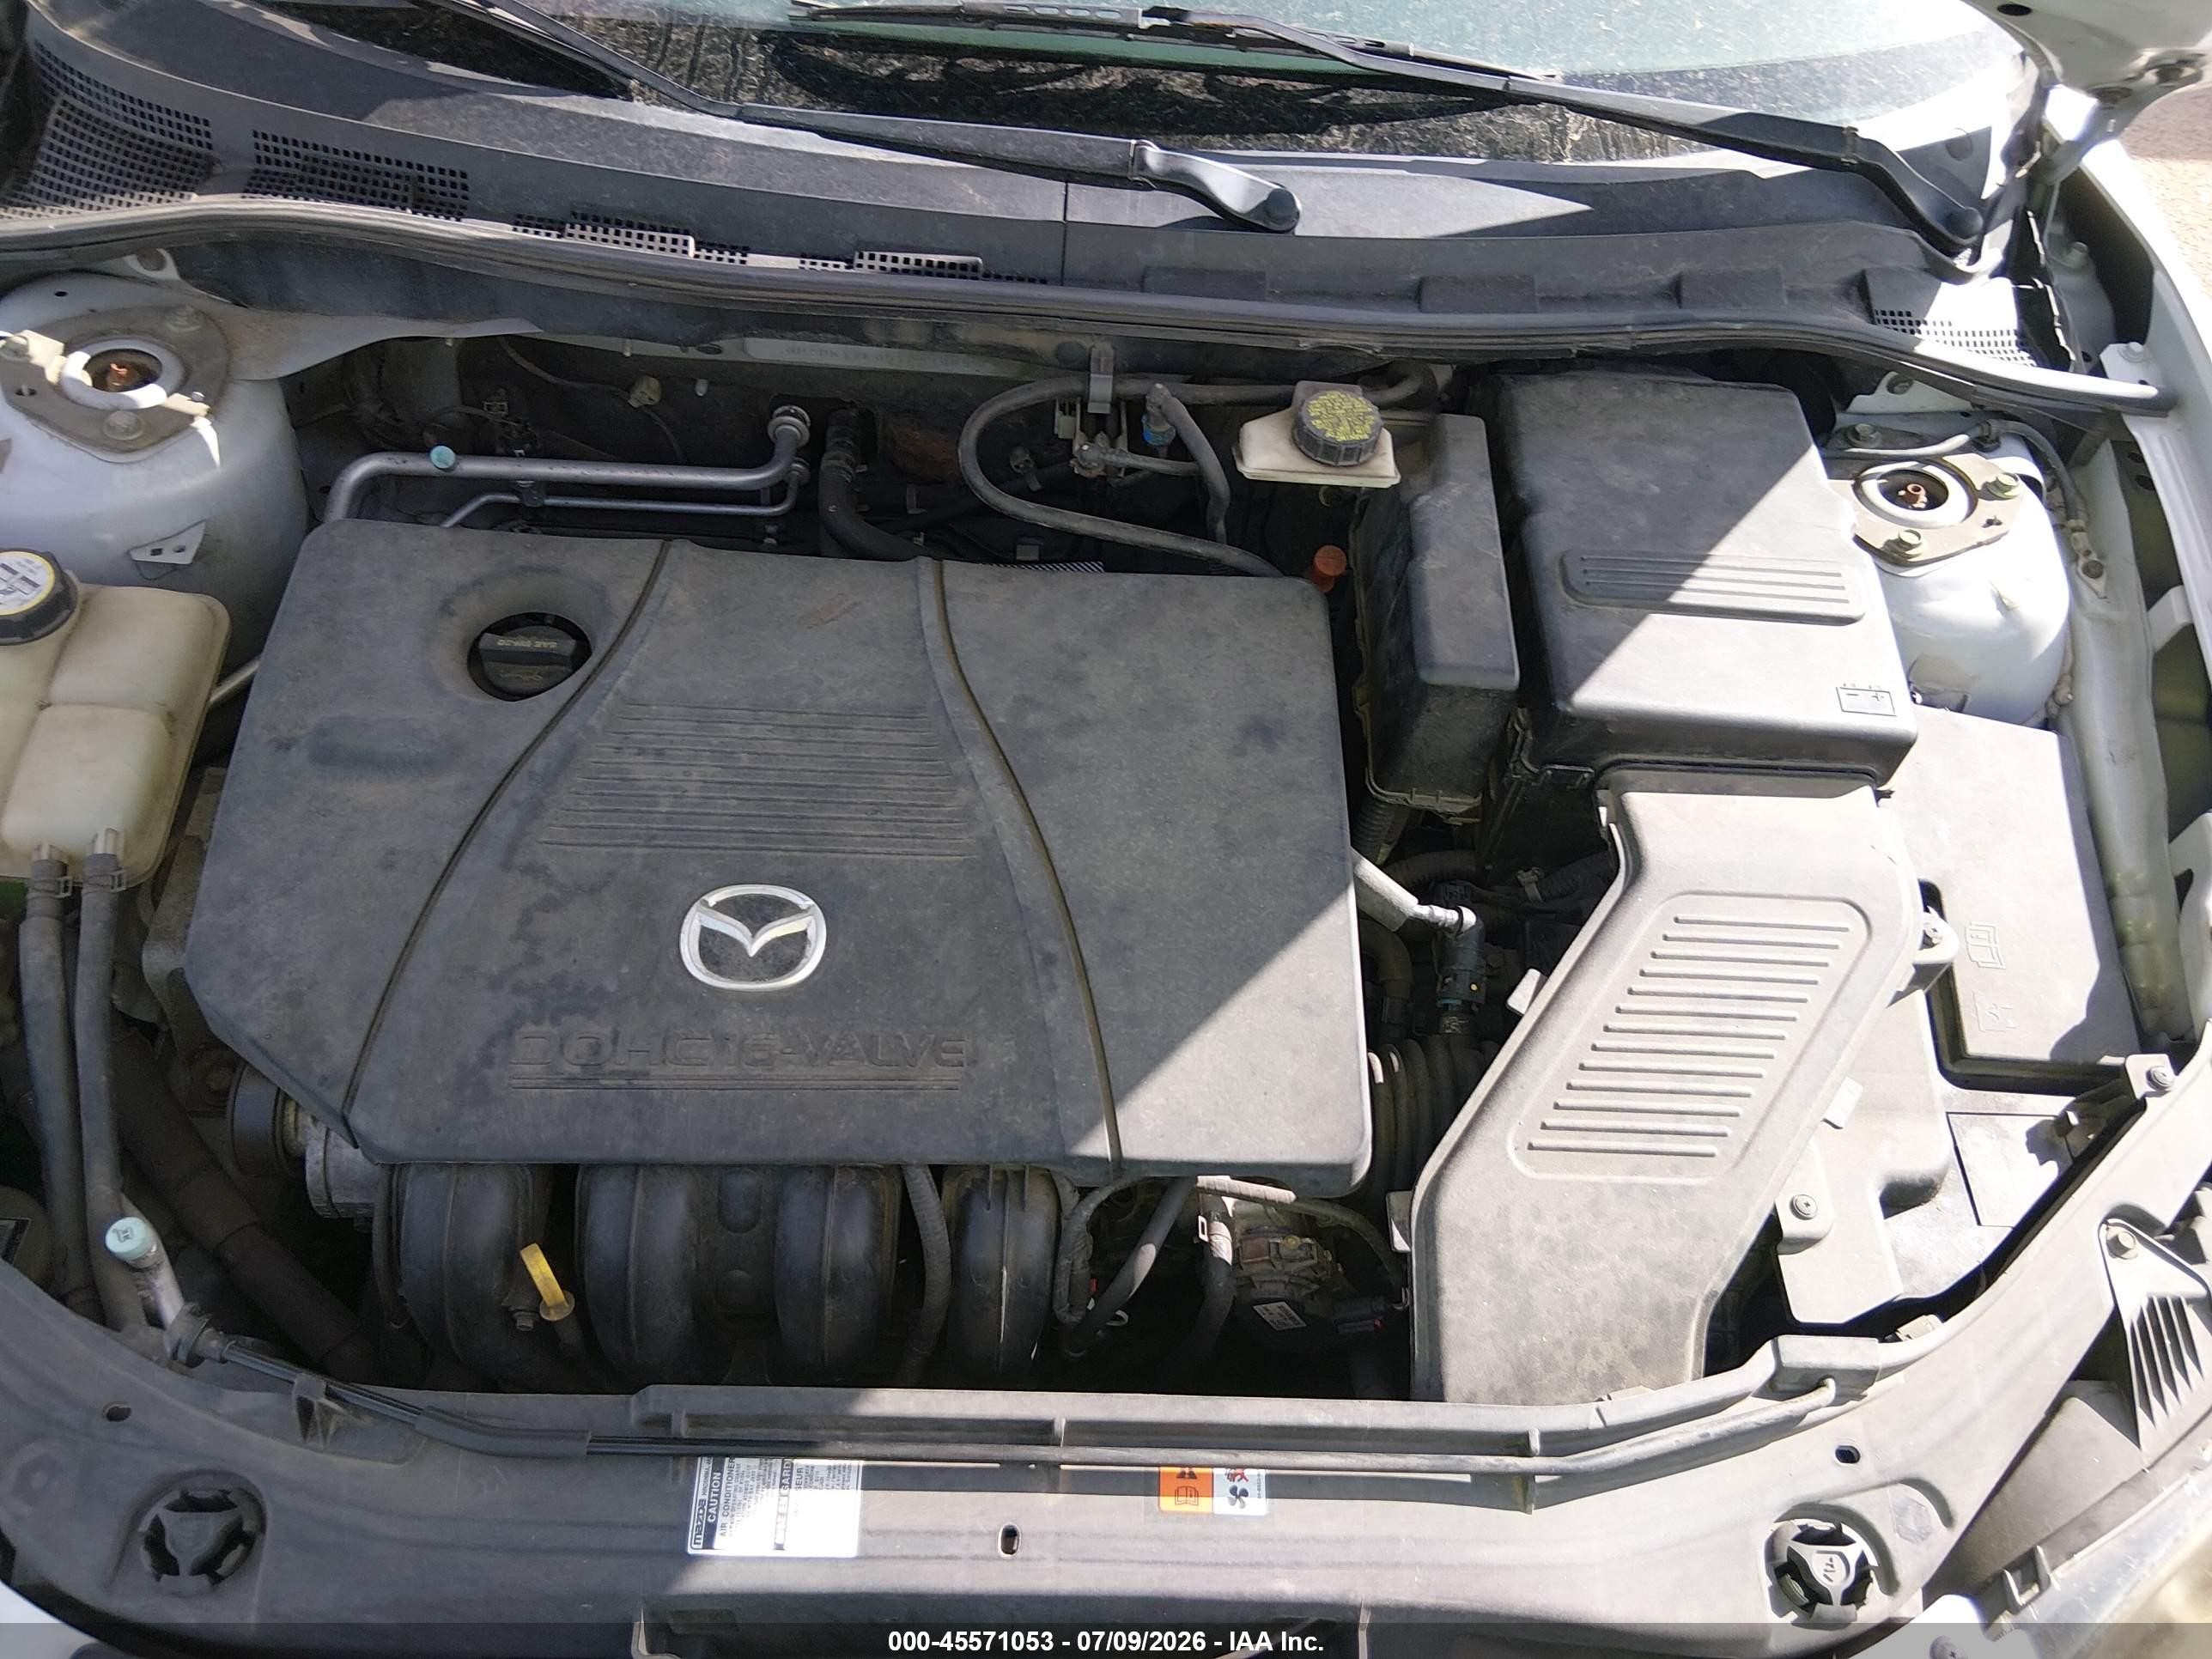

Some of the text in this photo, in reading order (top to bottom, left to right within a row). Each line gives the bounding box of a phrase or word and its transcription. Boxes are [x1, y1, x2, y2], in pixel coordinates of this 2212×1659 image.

[509, 1032, 968, 1068] DOHC 16-VALVE
[722, 1457, 736, 1517] CONDITIONER
[781, 1458, 793, 1492] GARD
[708, 1472, 721, 1522] CAUTION
[720, 1522, 728, 1537] AIR
